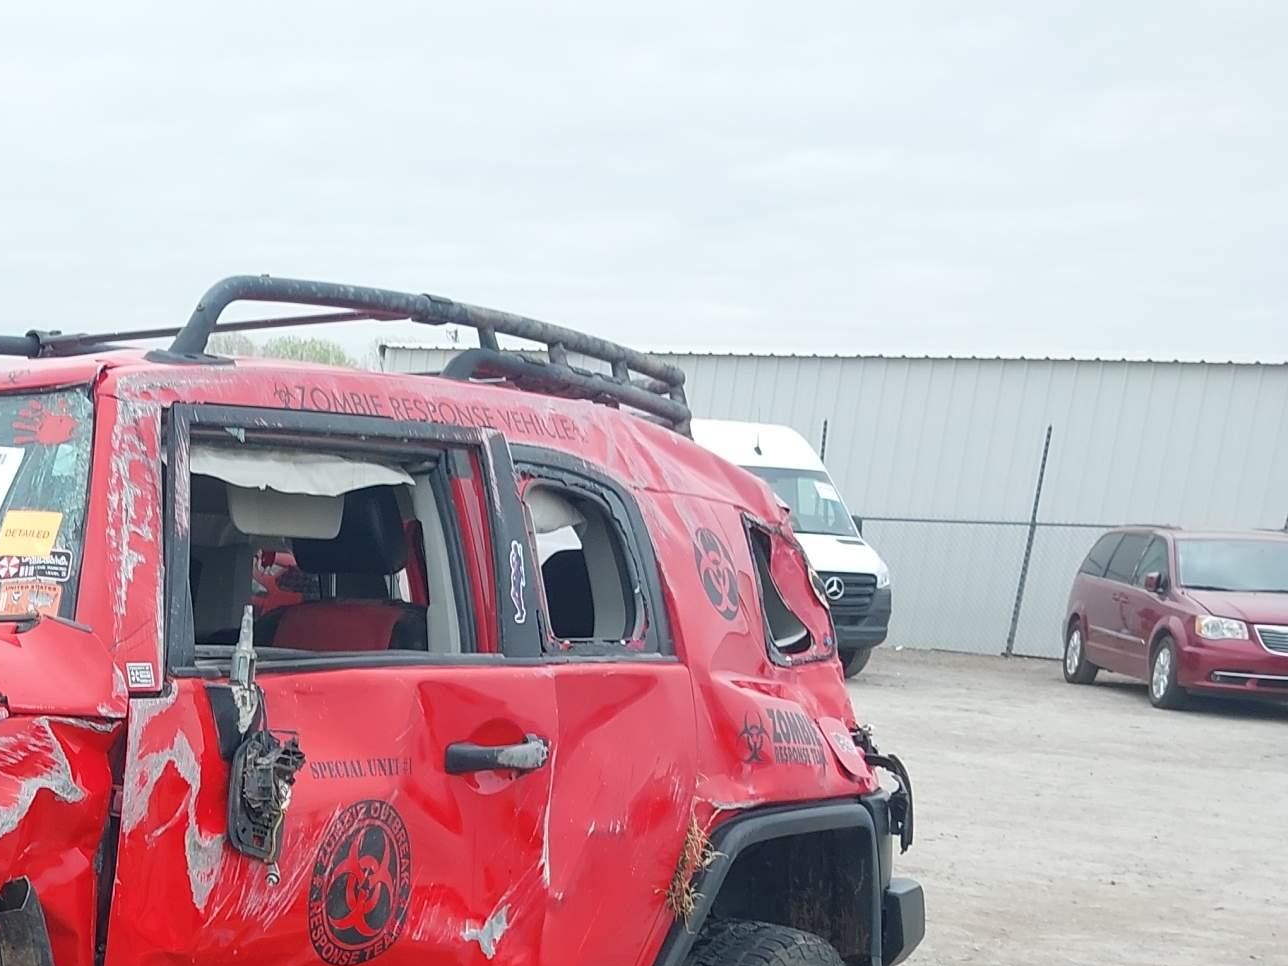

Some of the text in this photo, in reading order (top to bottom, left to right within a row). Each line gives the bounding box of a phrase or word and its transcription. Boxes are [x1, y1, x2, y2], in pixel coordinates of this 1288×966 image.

[389, 397, 496, 426] RESPONSE
[5, 528, 51, 539] DETAILED
[309, 759, 366, 780] SPECIAL
[367, 758, 399, 777] UNIT
[370, 801, 411, 888] OUTBREAK
[311, 900, 360, 966] RESPONSE
